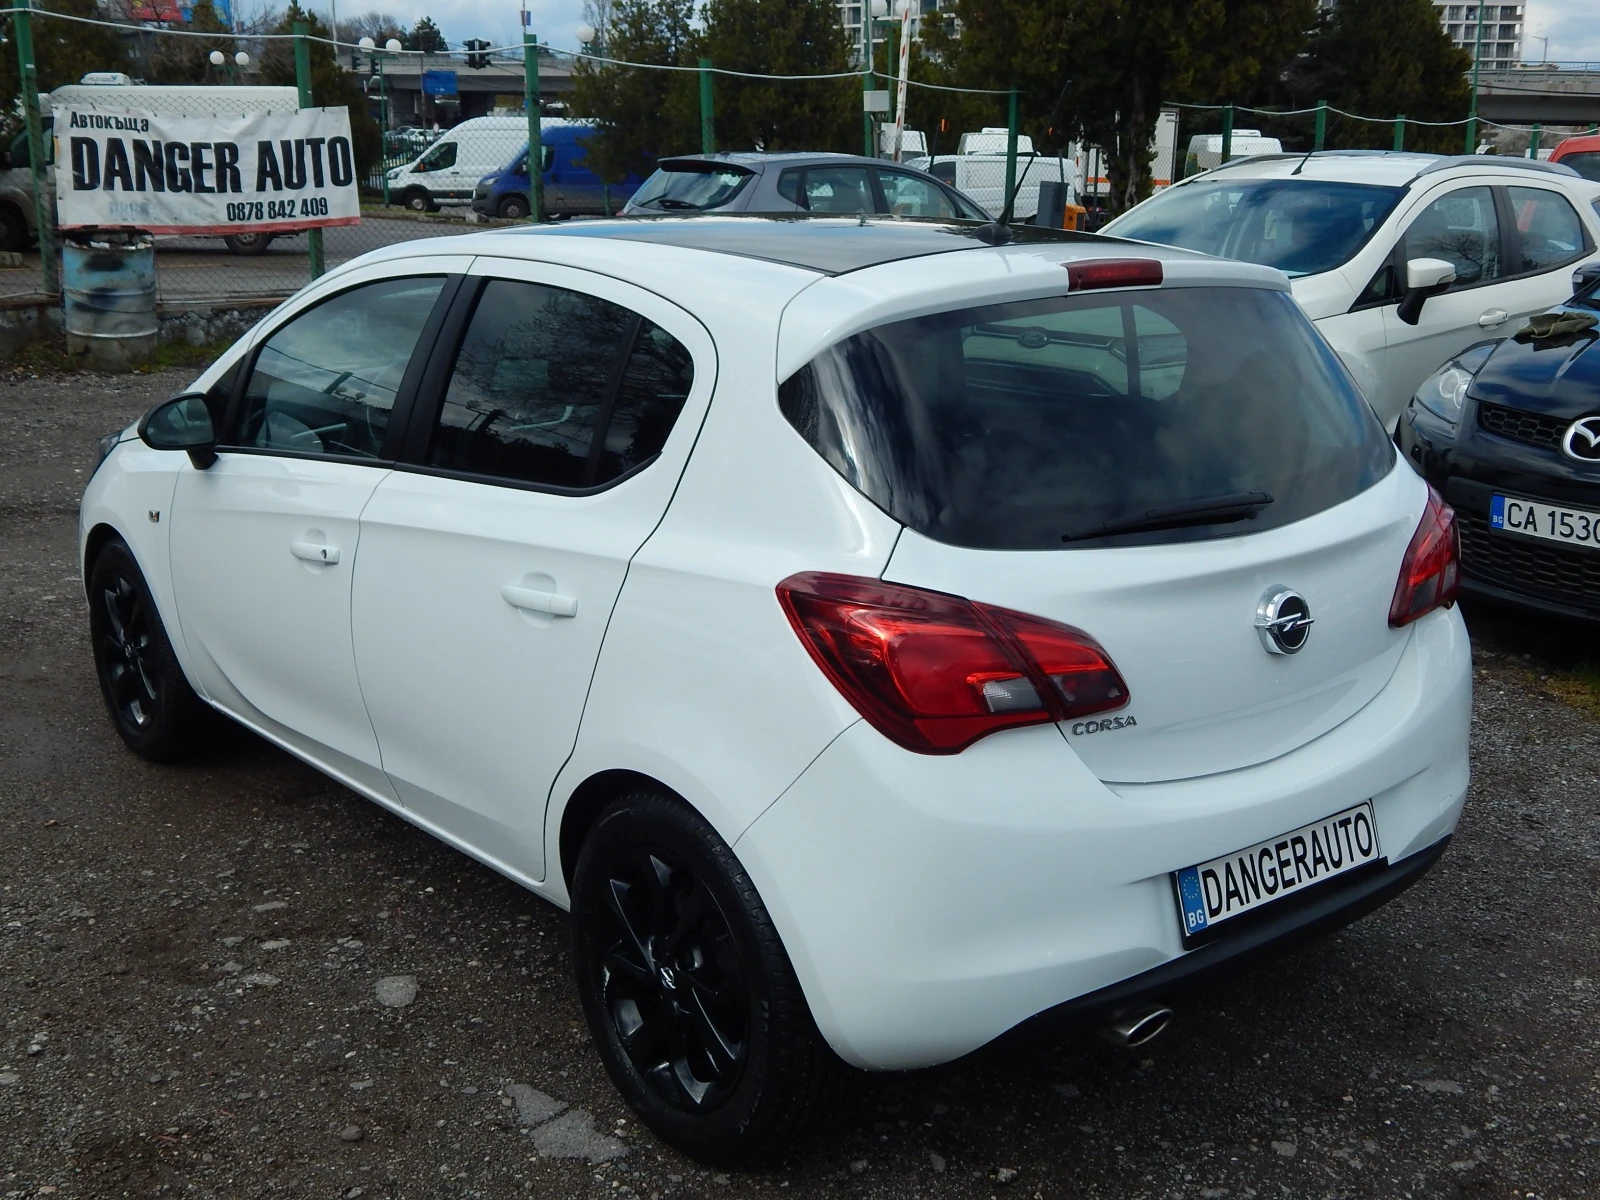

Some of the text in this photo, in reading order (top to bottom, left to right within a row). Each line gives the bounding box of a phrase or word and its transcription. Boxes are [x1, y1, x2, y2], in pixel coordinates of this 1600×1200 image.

[70, 111, 149, 133] Автокъща
[70, 136, 353, 193] DANGER AUTO
[226, 197, 328, 222] 0878 842 409
[1492, 515, 1503, 524] BG
[1507, 503, 1538, 532] CA
[1072, 715, 1137, 736] CORSA
[1201, 812, 1373, 919] DANGERAUTO
[1188, 909, 1205, 928] BG
